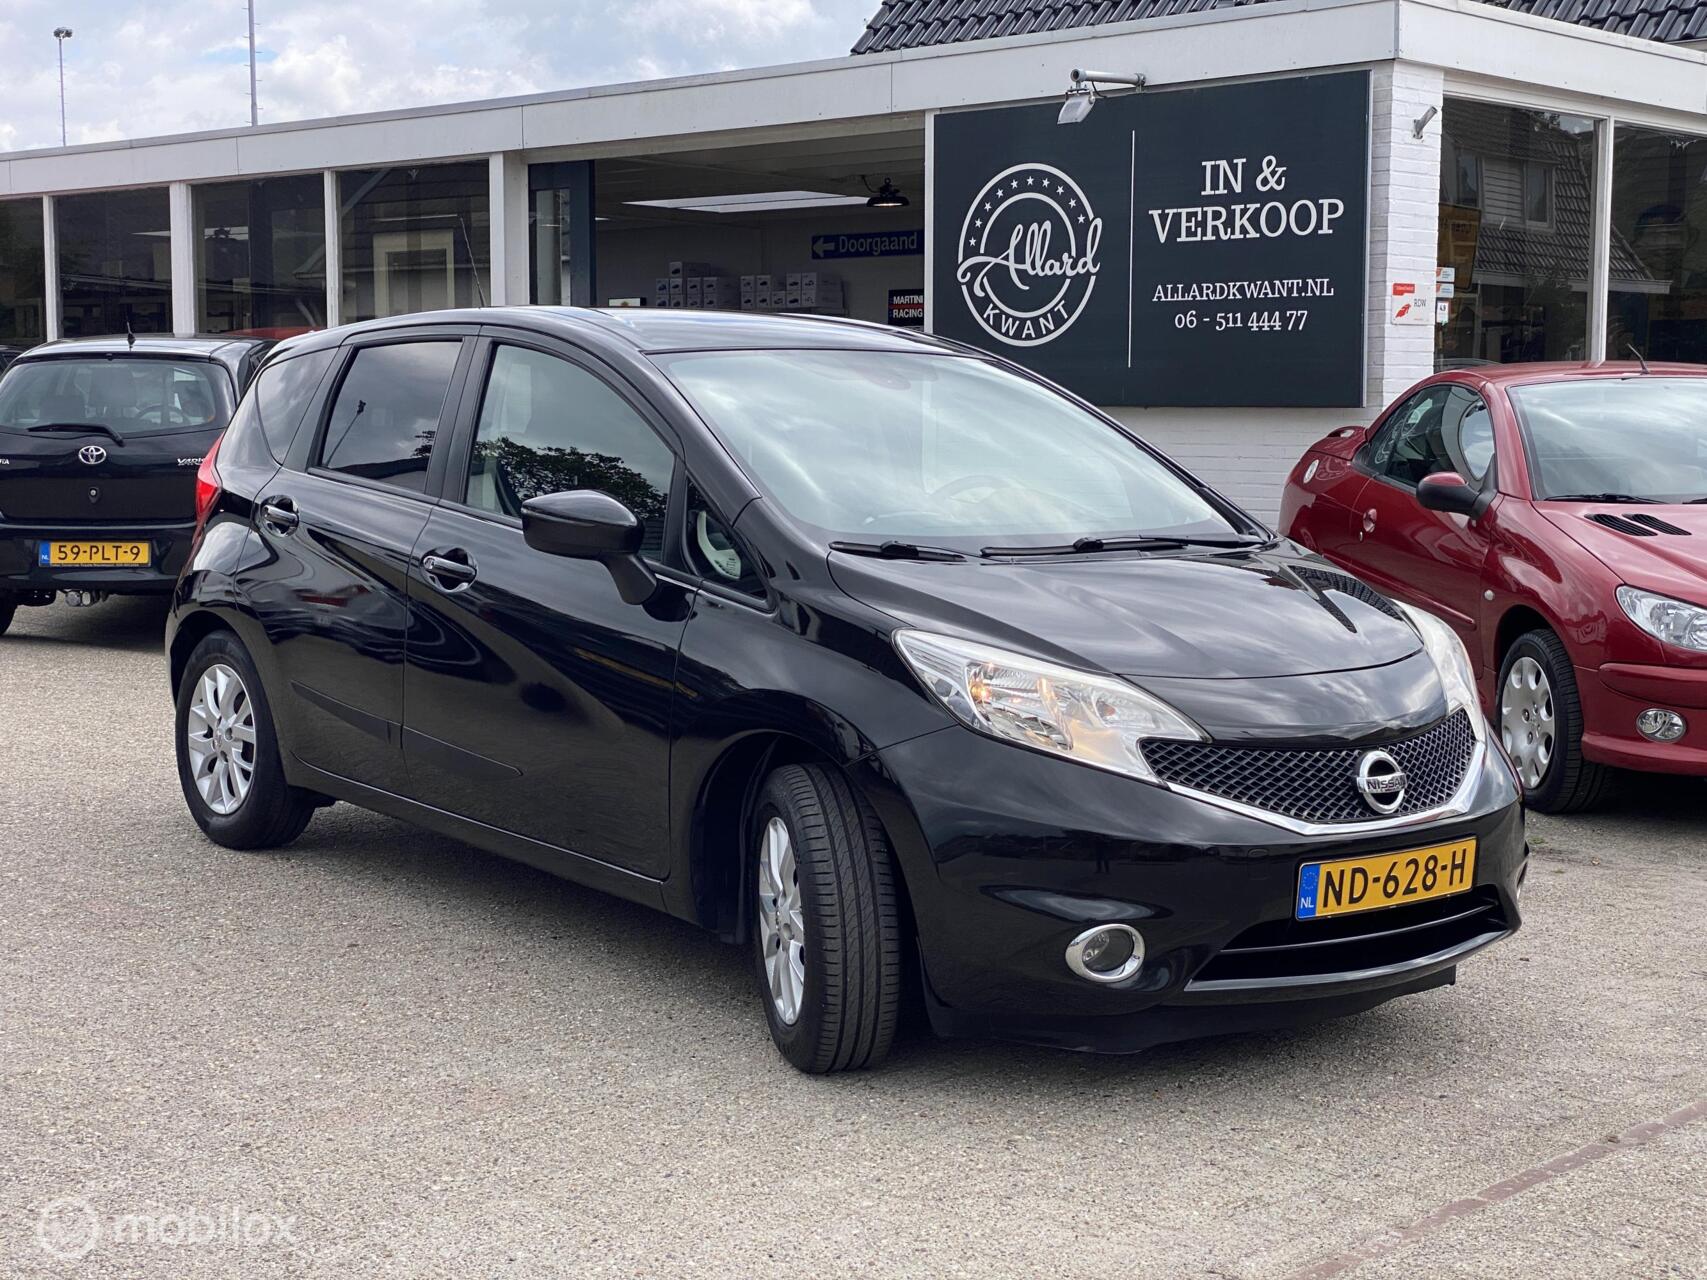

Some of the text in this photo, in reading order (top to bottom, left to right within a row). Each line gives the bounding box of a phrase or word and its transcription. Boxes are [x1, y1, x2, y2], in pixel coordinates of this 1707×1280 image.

[1201, 154, 1287, 195] IN &
[1148, 198, 1344, 244] VERKOOP
[839, 231, 917, 256] Doorgaand
[957, 217, 1103, 297] Allard
[893, 295, 924, 304] MARTINI
[1151, 278, 1335, 302] ALLARDKWANT.NL
[892, 308, 923, 318] RACING
[982, 299, 1071, 339] KWANT
[1174, 310, 1197, 329] 06
[1215, 312, 1243, 331] 511
[1247, 311, 1282, 331] 444
[1285, 310, 1308, 331] 77
[57, 544, 141, 561] 59-PLT-9
[1367, 777, 1407, 790] NISSAN
[1322, 848, 1467, 908] ND-628-H
[1300, 897, 1315, 908] NL
